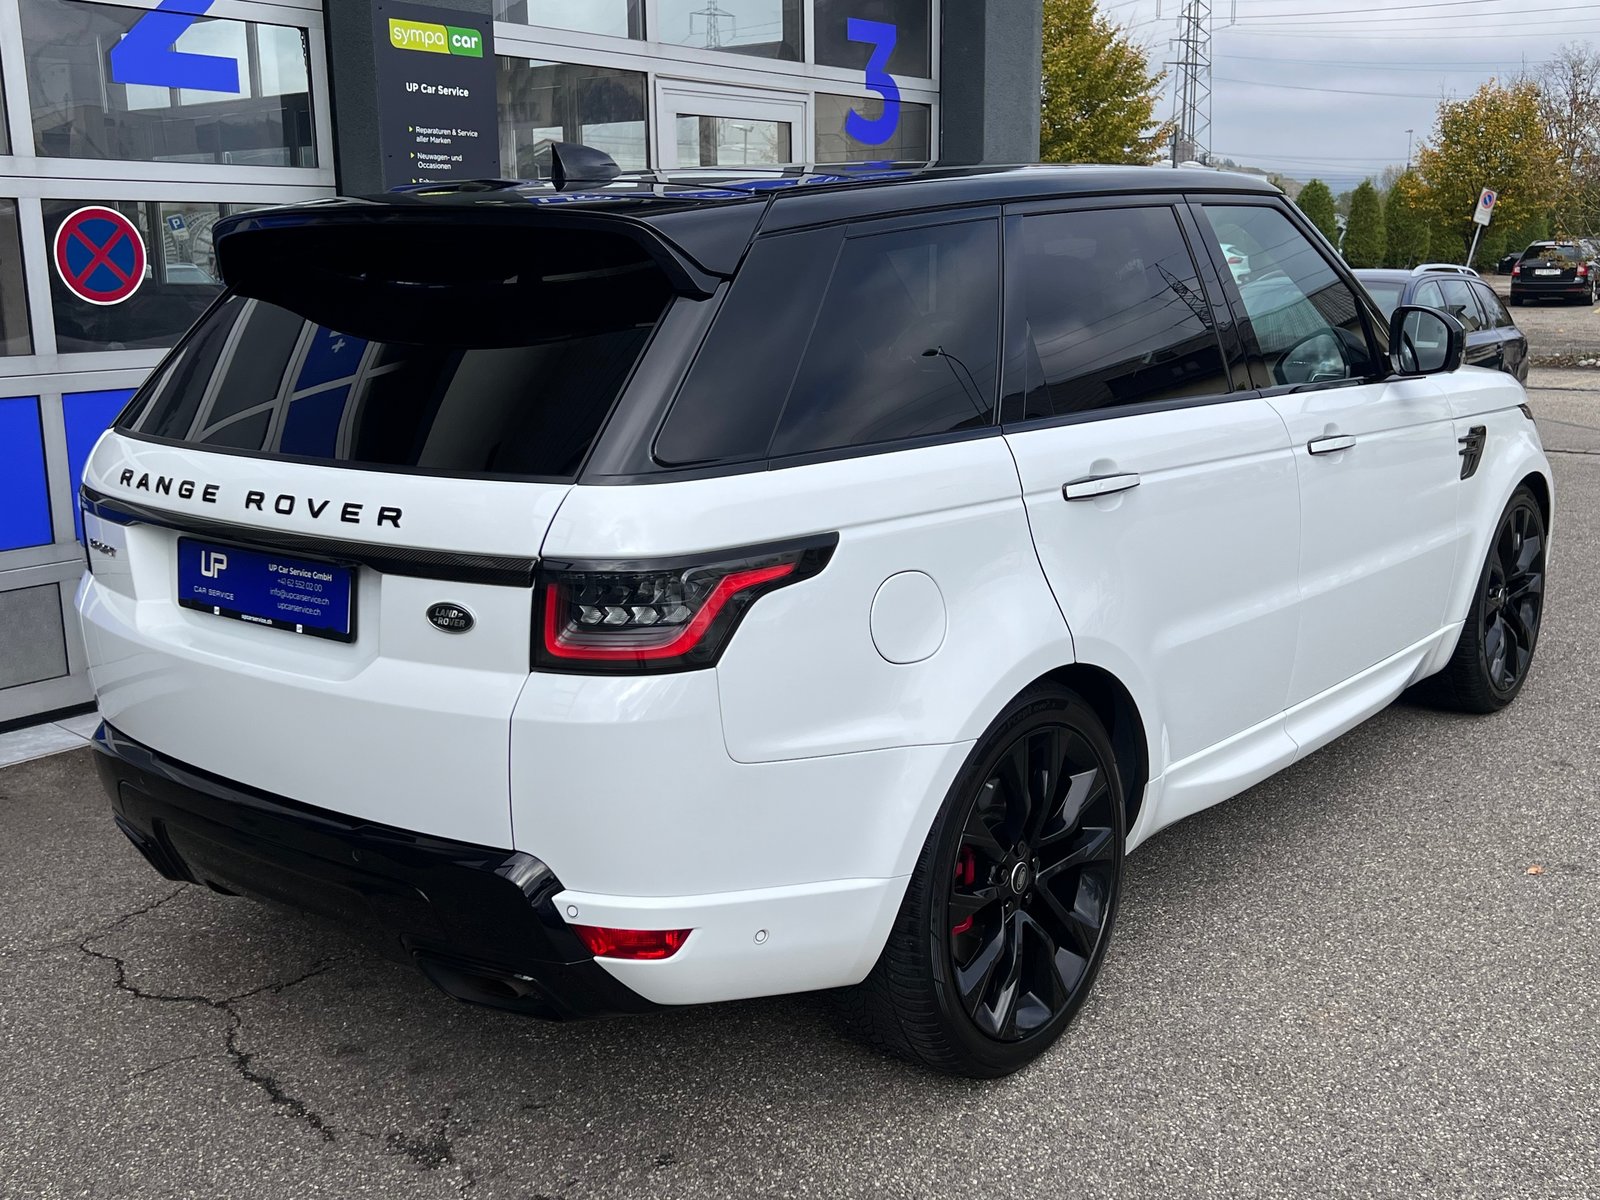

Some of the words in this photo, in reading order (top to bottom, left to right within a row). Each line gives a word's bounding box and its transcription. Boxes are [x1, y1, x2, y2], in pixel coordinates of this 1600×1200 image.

[393, 26, 445, 48] sympa
[452, 34, 479, 48] car
[845, 17, 901, 145] 3
[405, 82, 419, 92] UP
[420, 83, 436, 94] Car
[437, 85, 469, 97] Service
[415, 126, 451, 136] Reparaturen
[457, 129, 478, 138] Service
[429, 136, 452, 144] Marken
[417, 152, 450, 162] Neuwagen-
[451, 154, 463, 162] und
[417, 161, 452, 170] Occasionen
[172, 218, 180, 229] P
[119, 468, 220, 503] RANGE
[245, 490, 403, 528] ROVER
[201, 550, 227, 578] UP
[268, 563, 277, 571] UP
[278, 565, 289, 574] Car
[289, 567, 312, 578] Service
[312, 571, 333, 582] GmbH
[287, 578, 294, 588] 62
[295, 579, 305, 590] 552
[305, 582, 314, 591] 02
[314, 583, 323, 592] 00
[193, 585, 207, 594] CAR
[208, 588, 235, 601] SERVICE
[270, 586, 330, 606] info@upcarservice.ch
[277, 602, 322, 617] upcarservice.ch
[435, 607, 458, 618] LAND
[242, 613, 273, 625] upcarservice.ch
[437, 616, 466, 628] ROVER
